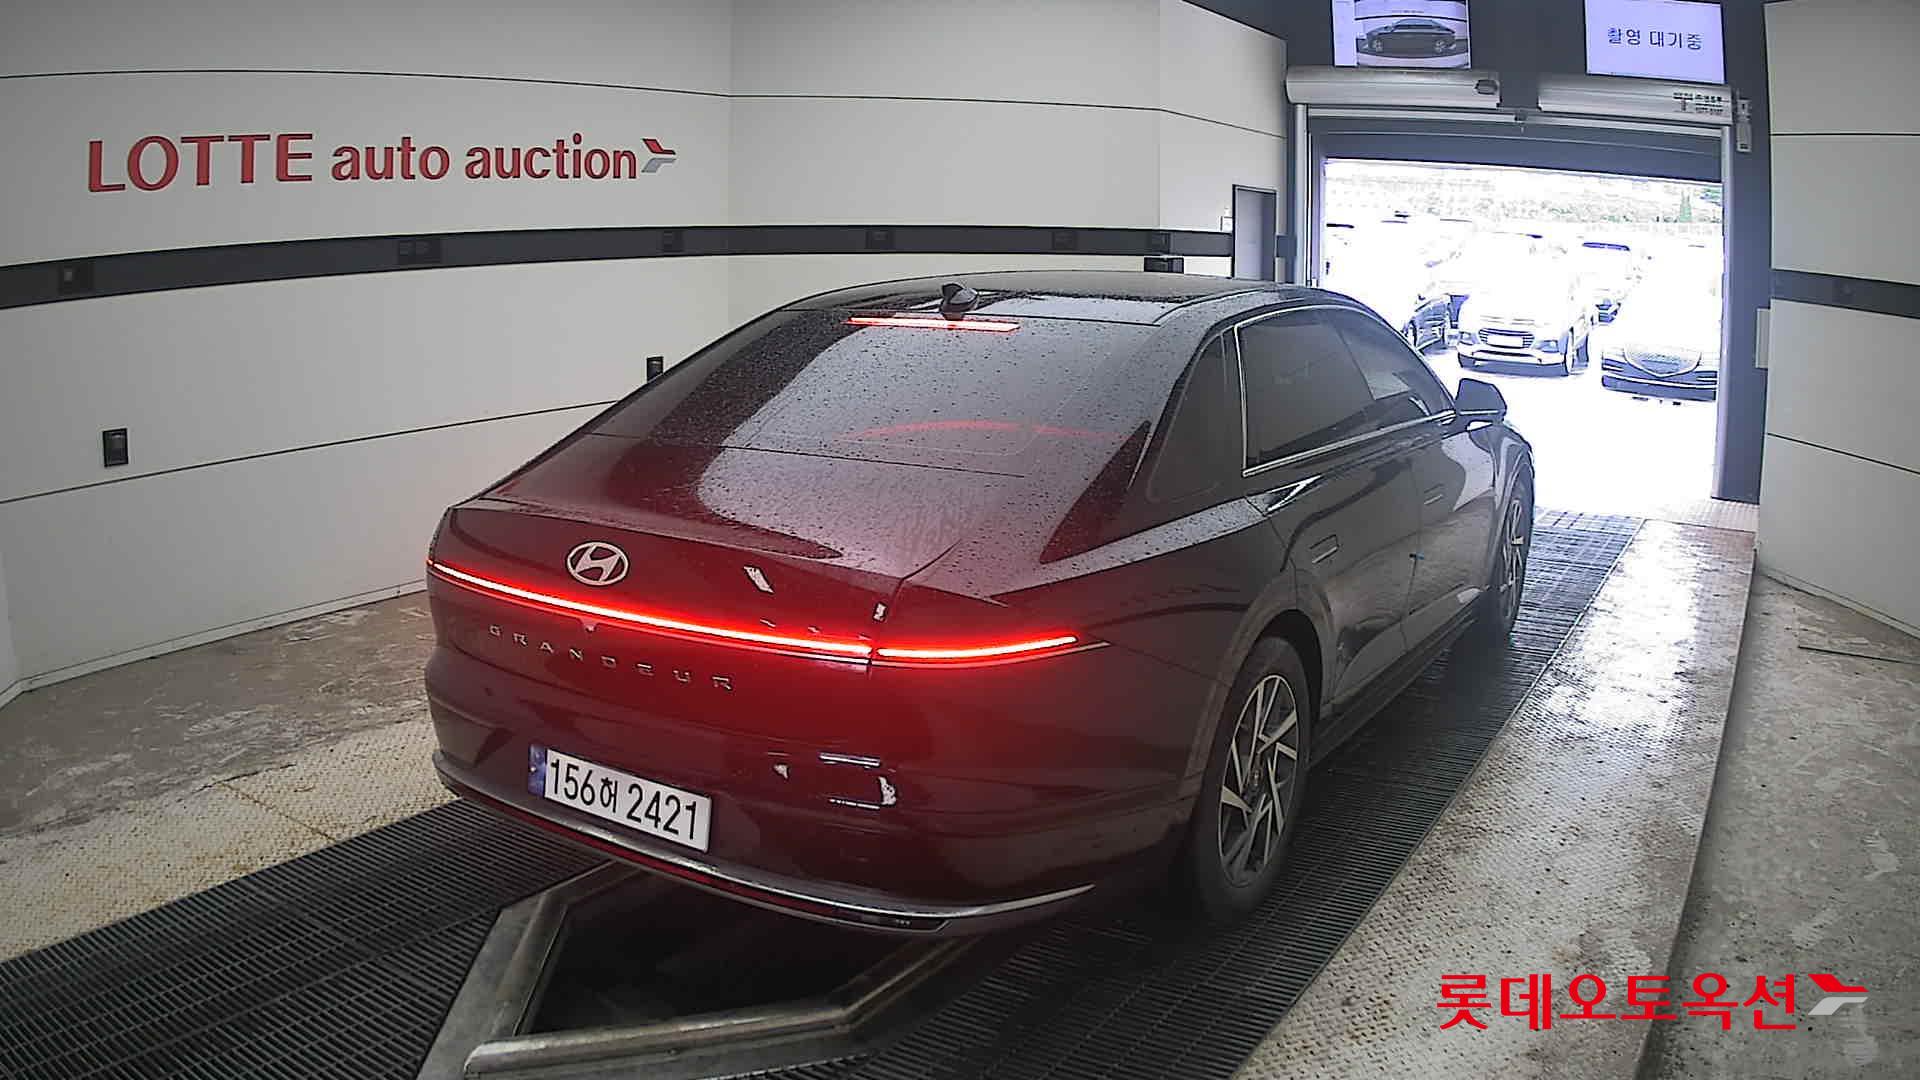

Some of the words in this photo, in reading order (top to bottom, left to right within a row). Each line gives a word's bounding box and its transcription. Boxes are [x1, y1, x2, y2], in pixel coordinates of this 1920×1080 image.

[1649, 30, 1702, 51] 대기중
[88, 133, 313, 192] LOTTE
[331, 136, 450, 181] auto
[464, 132, 637, 180] auction
[489, 625, 733, 691] GRANDEUR
[550, 758, 617, 813] 156허
[626, 783, 697, 840] 2421
